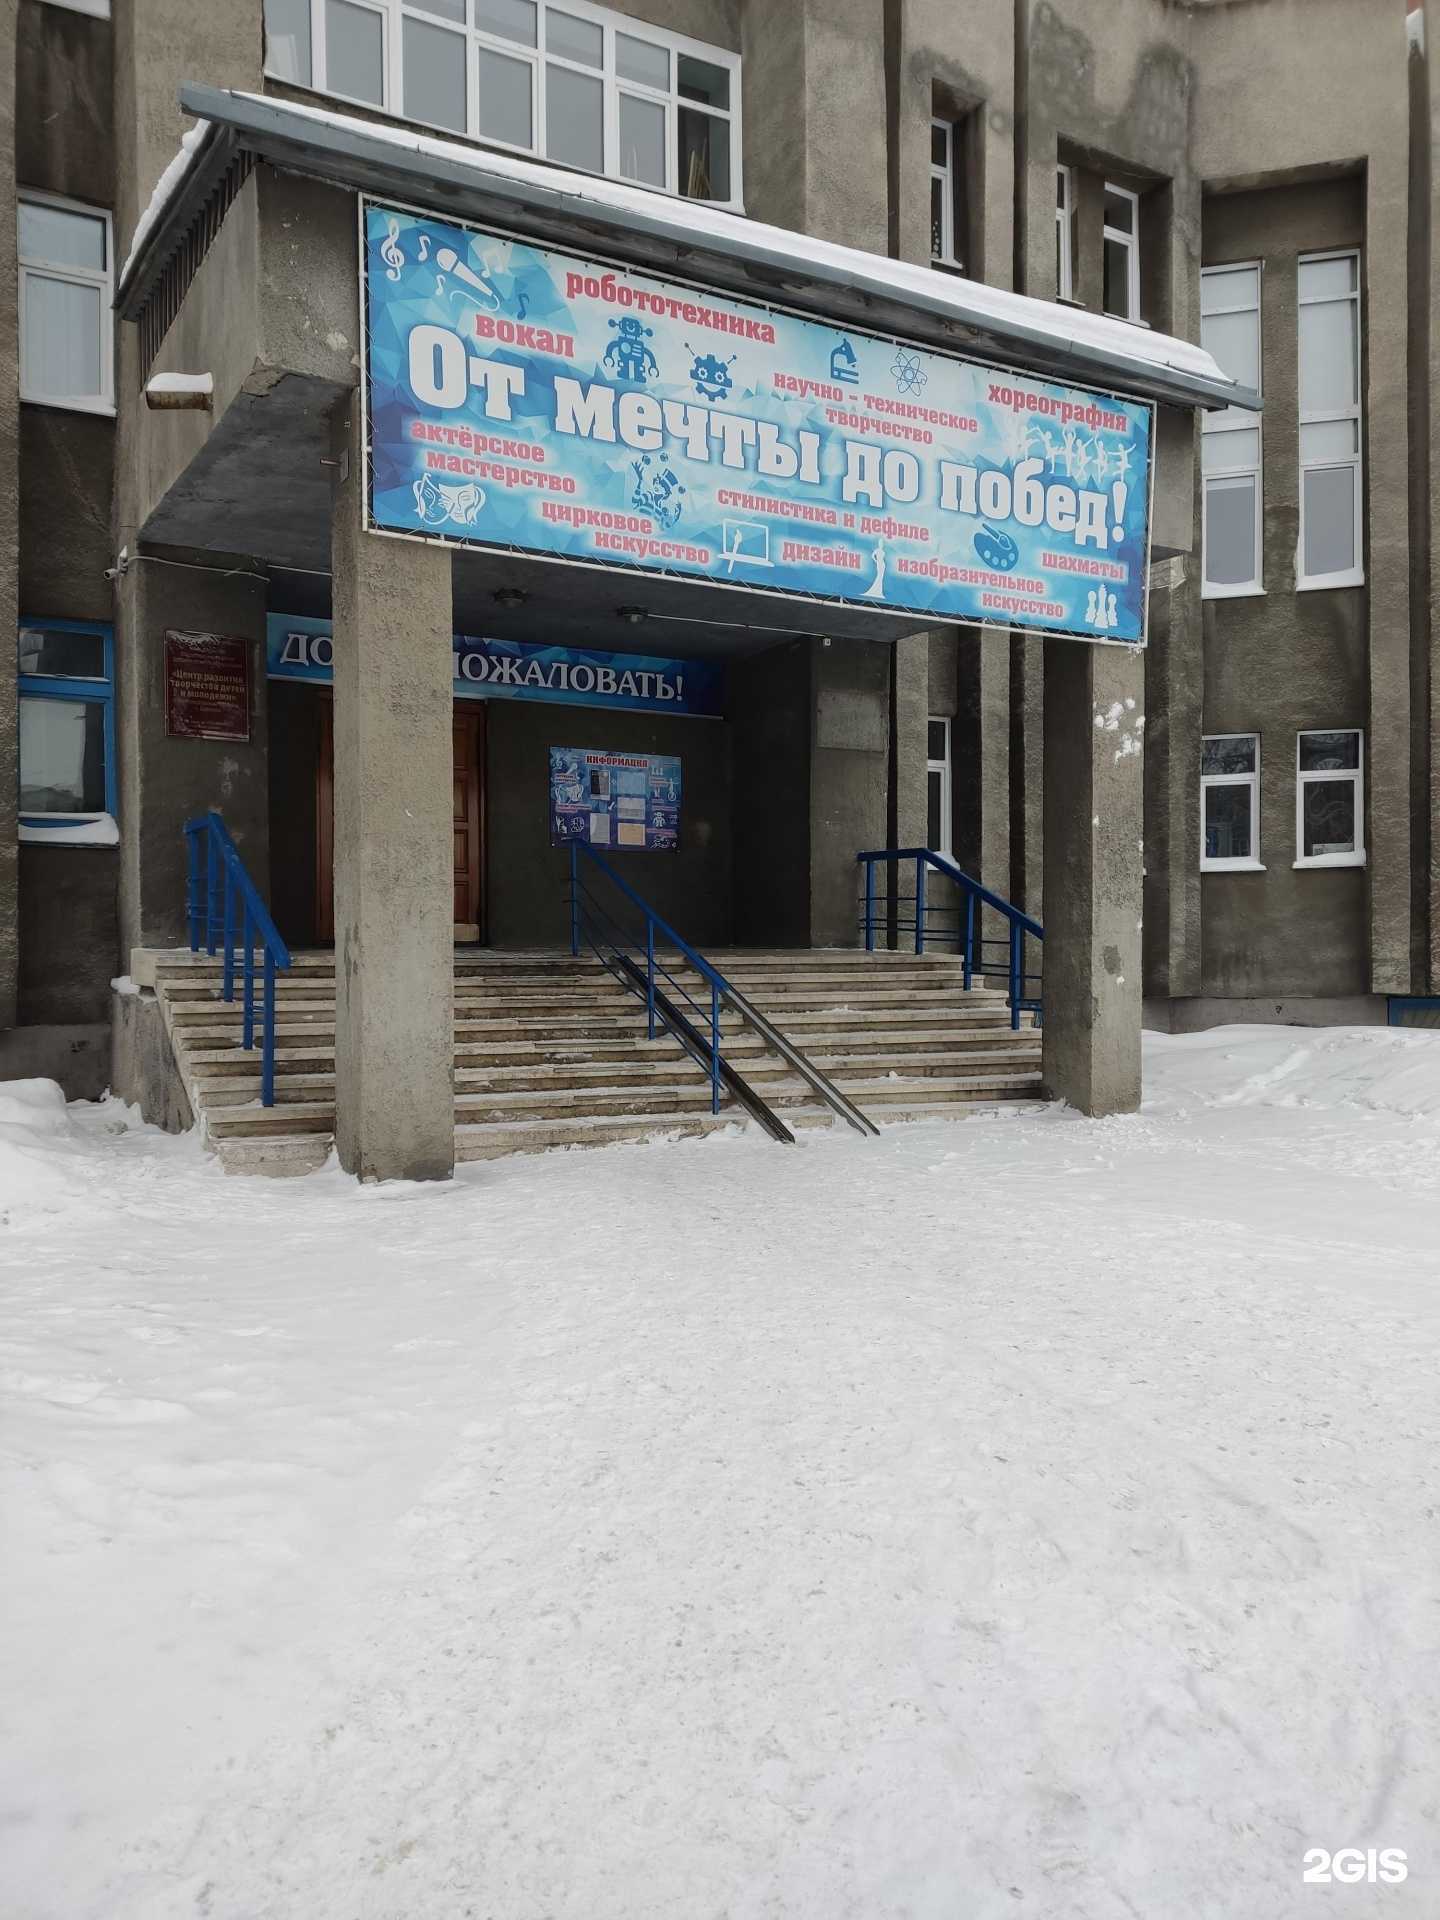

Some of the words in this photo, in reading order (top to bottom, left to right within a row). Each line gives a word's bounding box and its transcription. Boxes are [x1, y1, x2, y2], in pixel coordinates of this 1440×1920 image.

[566, 271, 775, 344] робототехника
[475, 313, 575, 358] вокал
[773, 372, 844, 402] научно
[863, 394, 978, 433] техническое
[987, 382, 1128, 433] хореография
[408, 324, 526, 422] От
[554, 375, 821, 485] мечты
[842, 439, 920, 509] до
[940, 458, 1125, 550] побед!
[411, 420, 546, 463] актёрское
[825, 408, 933, 445] творчество
[426, 450, 577, 494] мастерство
[541, 500, 653, 535] цирковое
[717, 488, 838, 528] стилистика
[842, 509, 856, 529] и
[860, 516, 930, 542] дефиле
[595, 530, 711, 565] искусство
[782, 540, 862, 570] дизайн
[1041, 551, 1125, 580] шахматы
[897, 557, 1045, 595] изобразительное
[981, 591, 1064, 618] искусство
[586, 755, 649, 768] ИНФОРМАЦИЯ
